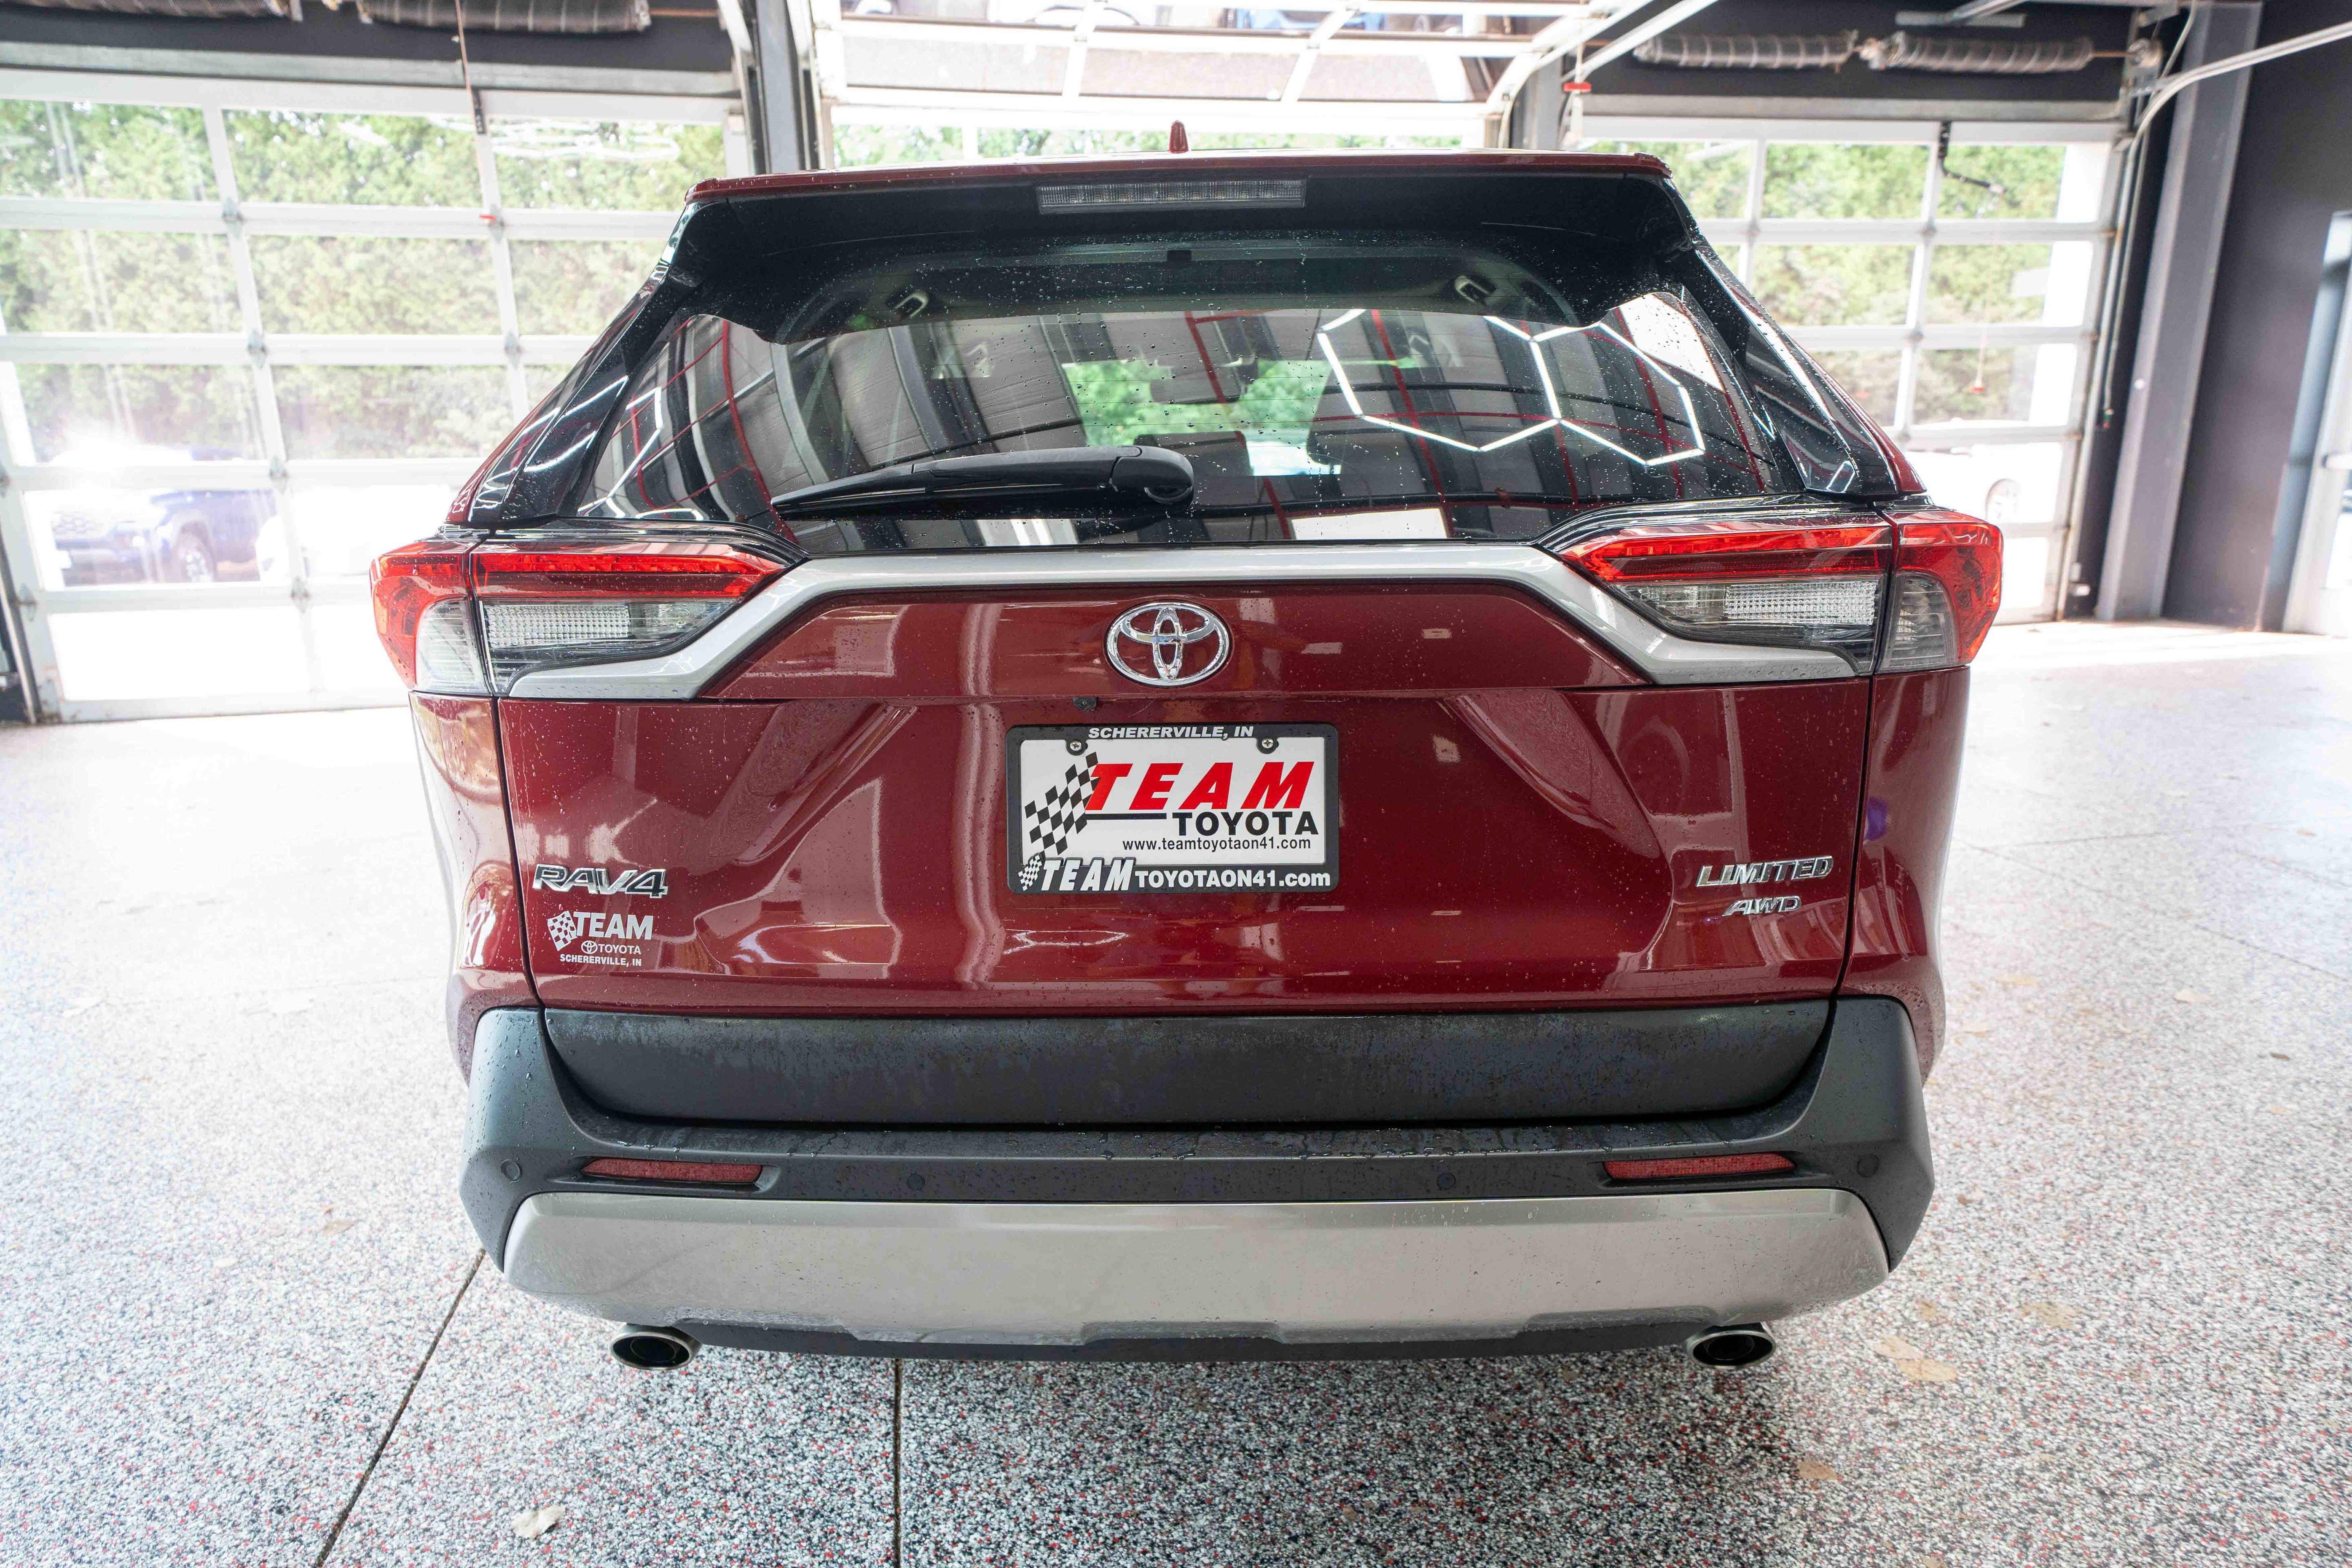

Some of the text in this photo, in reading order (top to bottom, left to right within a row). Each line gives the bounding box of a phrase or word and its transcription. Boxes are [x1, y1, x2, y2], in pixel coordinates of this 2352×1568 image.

[1088, 726, 1254, 739] SCHERERVILLE, IN
[1085, 761, 1314, 811] TEAM
[1172, 811, 1319, 836] TOYOTA
[1123, 837, 1311, 853] www.teamtoyotaon41.com
[532, 864, 668, 898] RAV4
[1042, 858, 1330, 892] TEAM TOYOTAON41.com
[1696, 855, 1833, 887] LIMITED
[1722, 895, 1802, 916] AWD
[573, 911, 653, 940] TEAM
[560, 954, 629, 967] SCHERERVILLE,
[598, 944, 641, 954] TOYOTA
